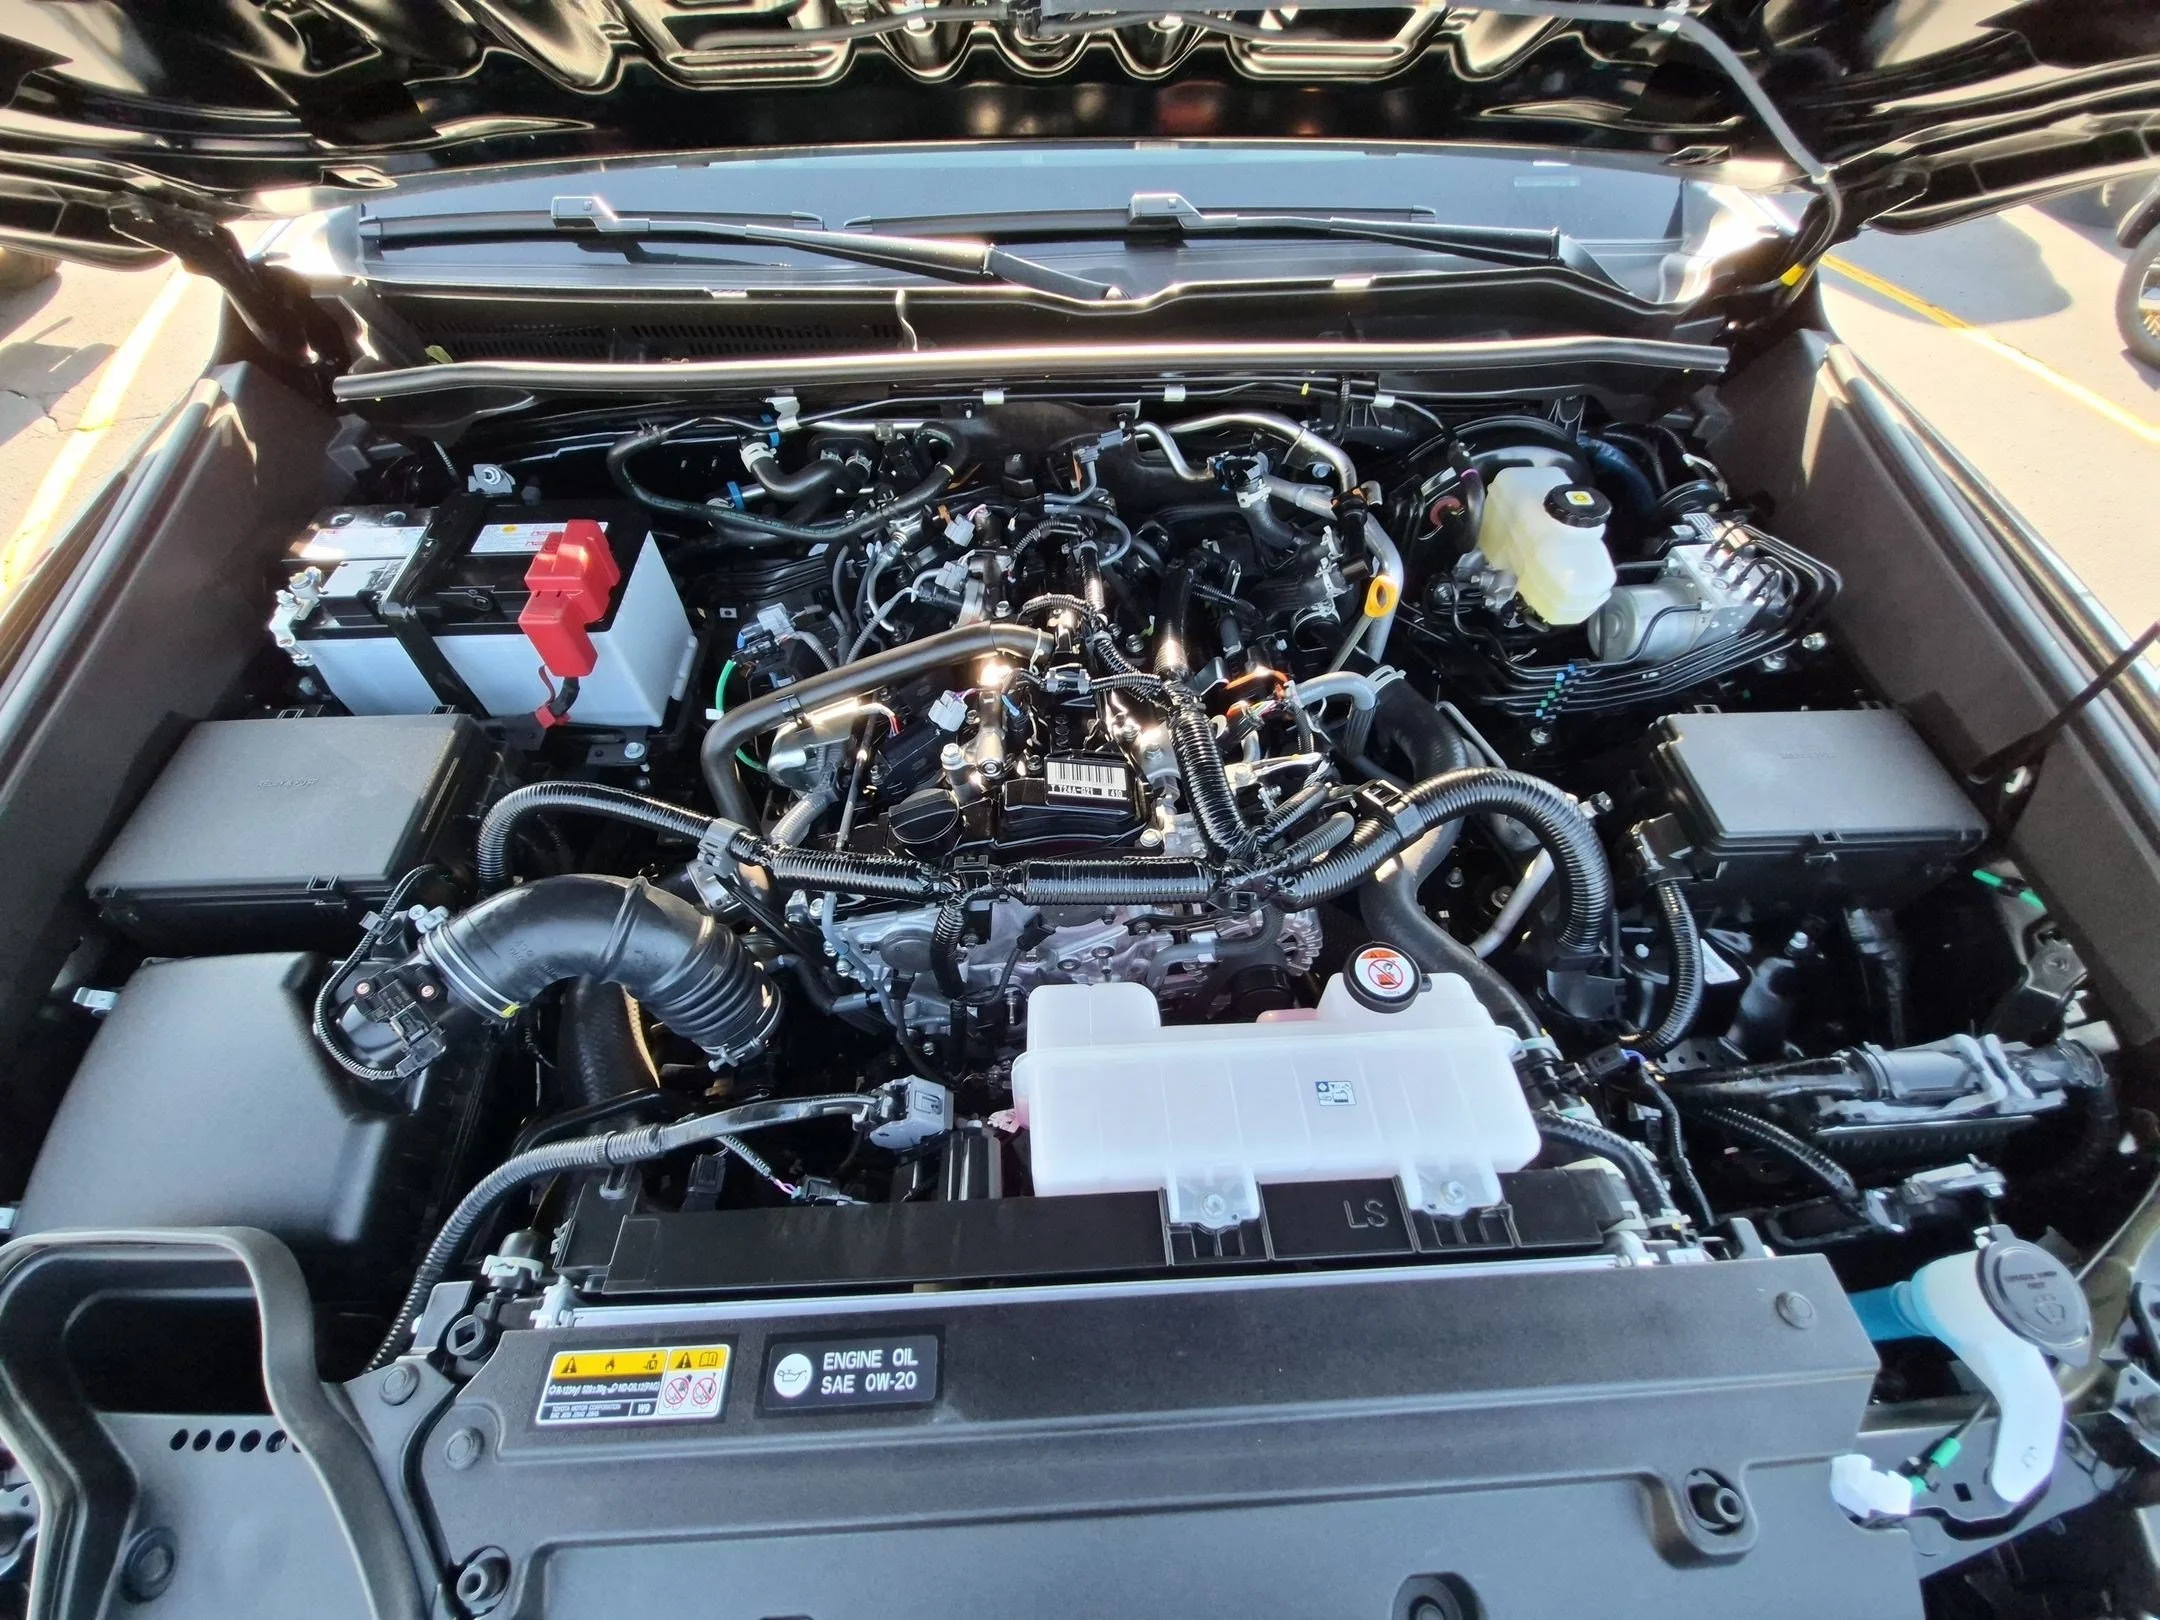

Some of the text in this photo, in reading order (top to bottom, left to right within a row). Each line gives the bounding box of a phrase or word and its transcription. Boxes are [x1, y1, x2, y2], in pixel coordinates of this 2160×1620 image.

[1343, 1199, 1389, 1229] LS
[823, 1347, 919, 1371] ENGINE OIL
[820, 1370, 918, 1395] SAE 0W-20
[637, 1403, 651, 1414] W9
